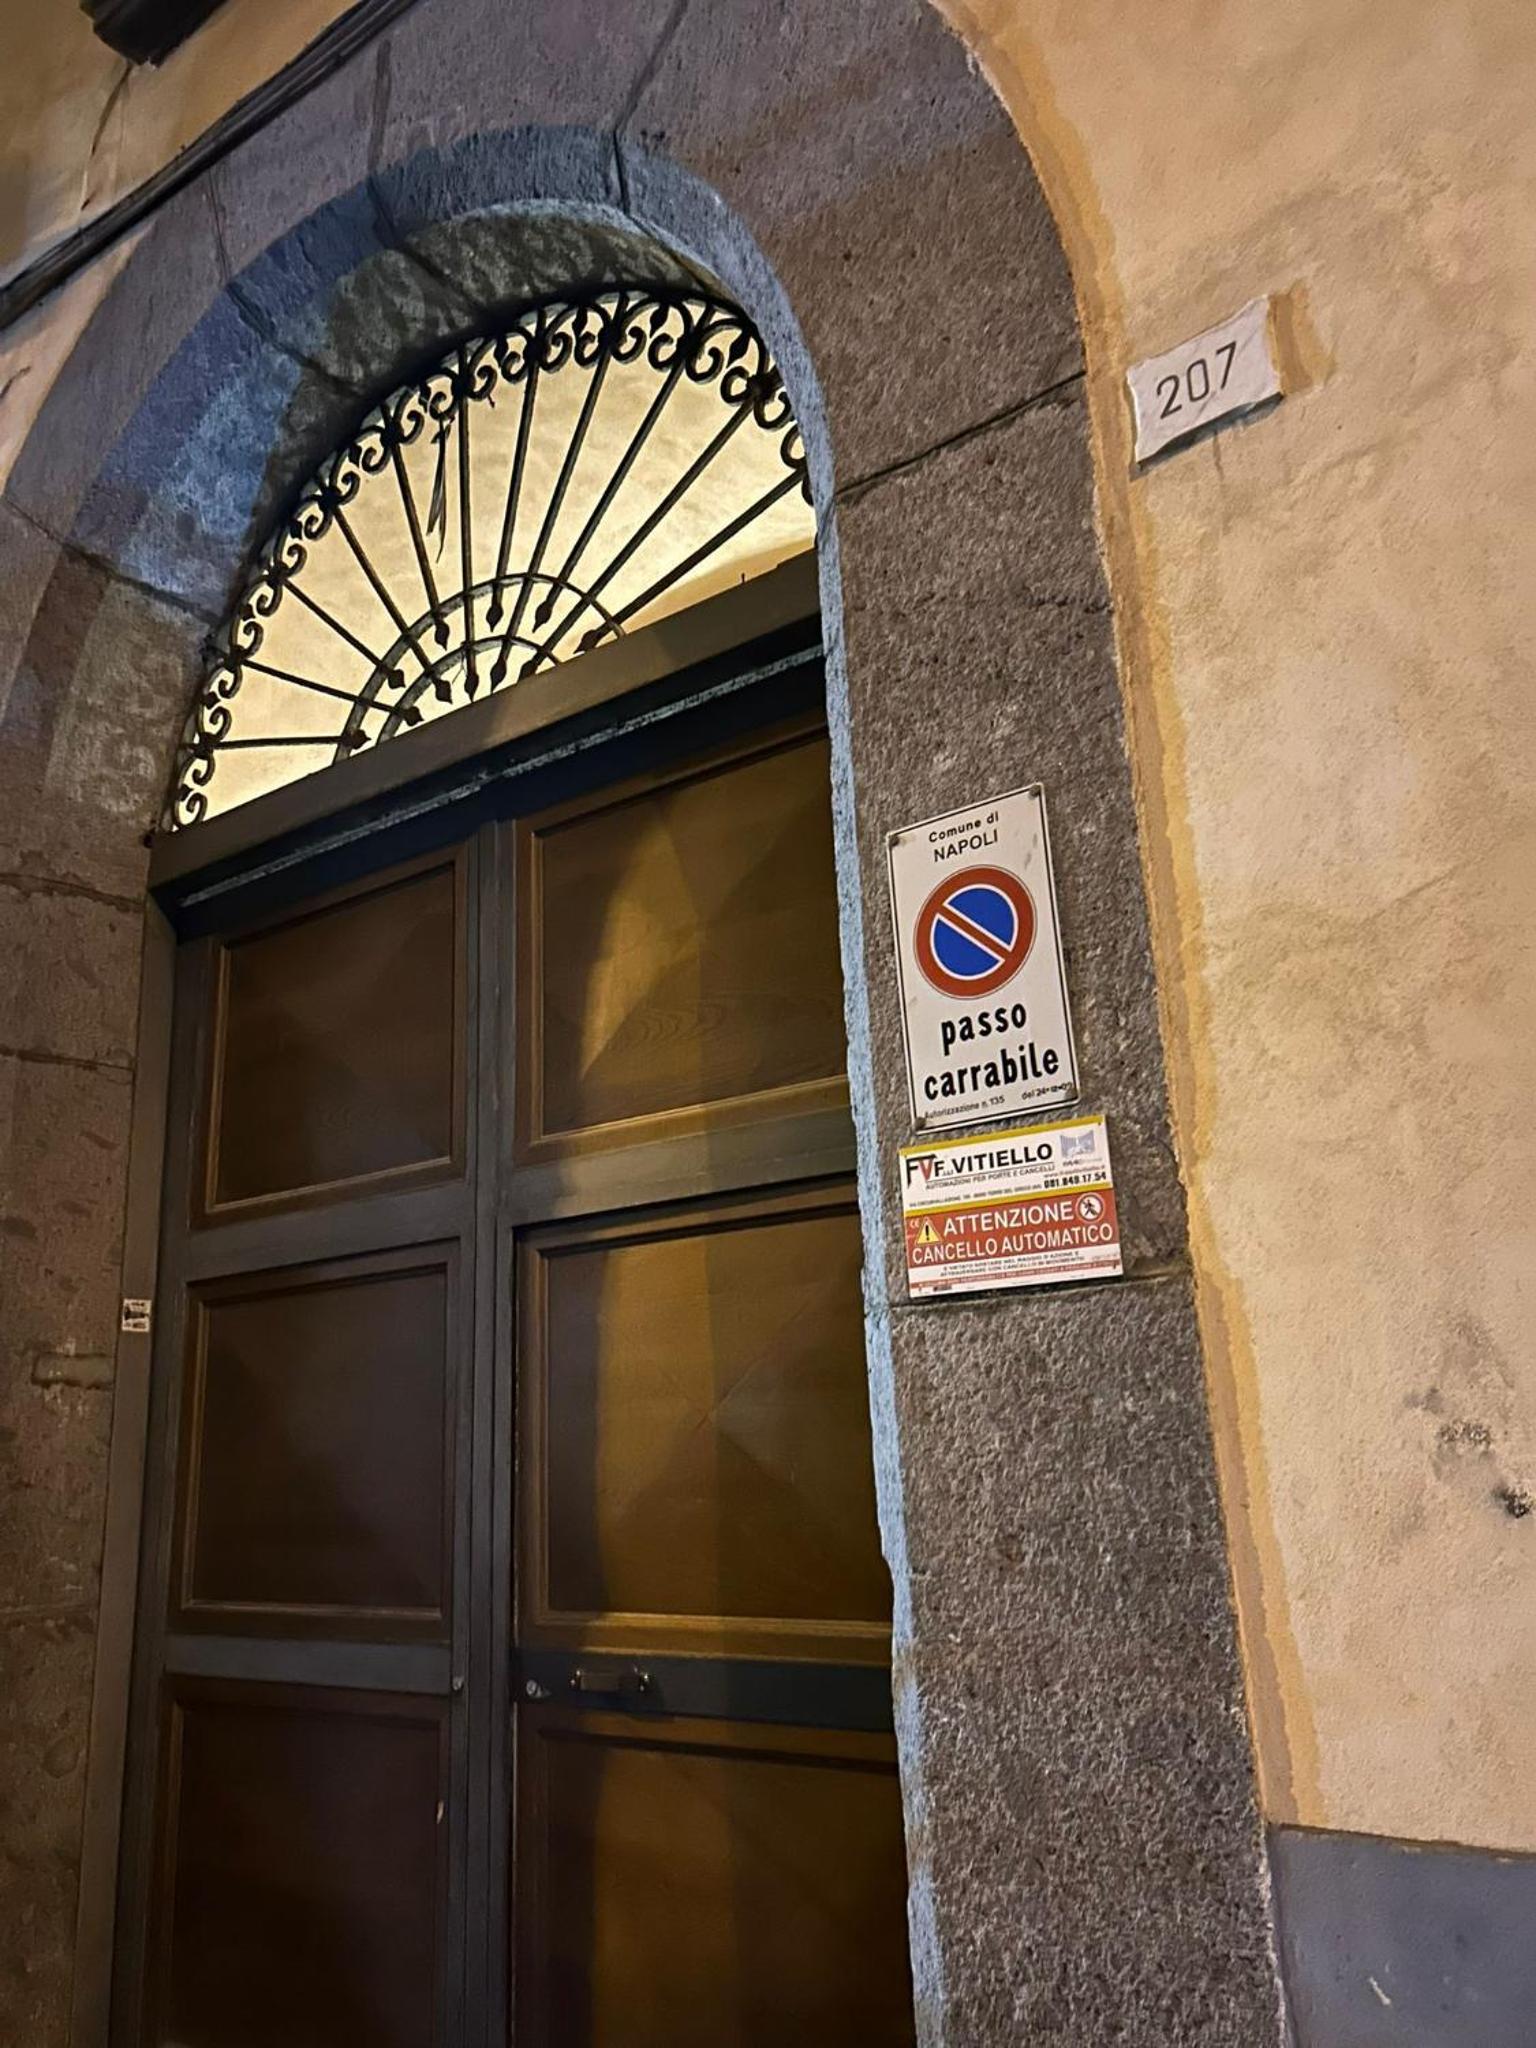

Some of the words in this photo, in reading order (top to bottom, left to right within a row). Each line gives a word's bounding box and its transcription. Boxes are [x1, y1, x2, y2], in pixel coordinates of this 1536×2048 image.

[1156, 340, 1237, 419] 207
[929, 820, 982, 843] Comune
[986, 810, 999, 824] di
[933, 828, 998, 863] NAPOLI
[941, 1003, 1027, 1055] passo
[924, 1042, 1059, 1100] carrabile
[924, 1101, 980, 1119] Autorizzazione
[989, 1095, 1006, 1106] 135
[1022, 1088, 1035, 1100] del
[951, 1143, 1053, 1174] VITIELLO
[972, 1174, 986, 1183] PER
[987, 1170, 1011, 1181] PORTE
[1018, 1163, 1055, 1176] CANCELLI
[943, 1201, 1074, 1236] ATTENZIONE
[912, 1238, 998, 1265] CANCELLO
[1001, 1223, 1113, 1254] AUTOMATICO
